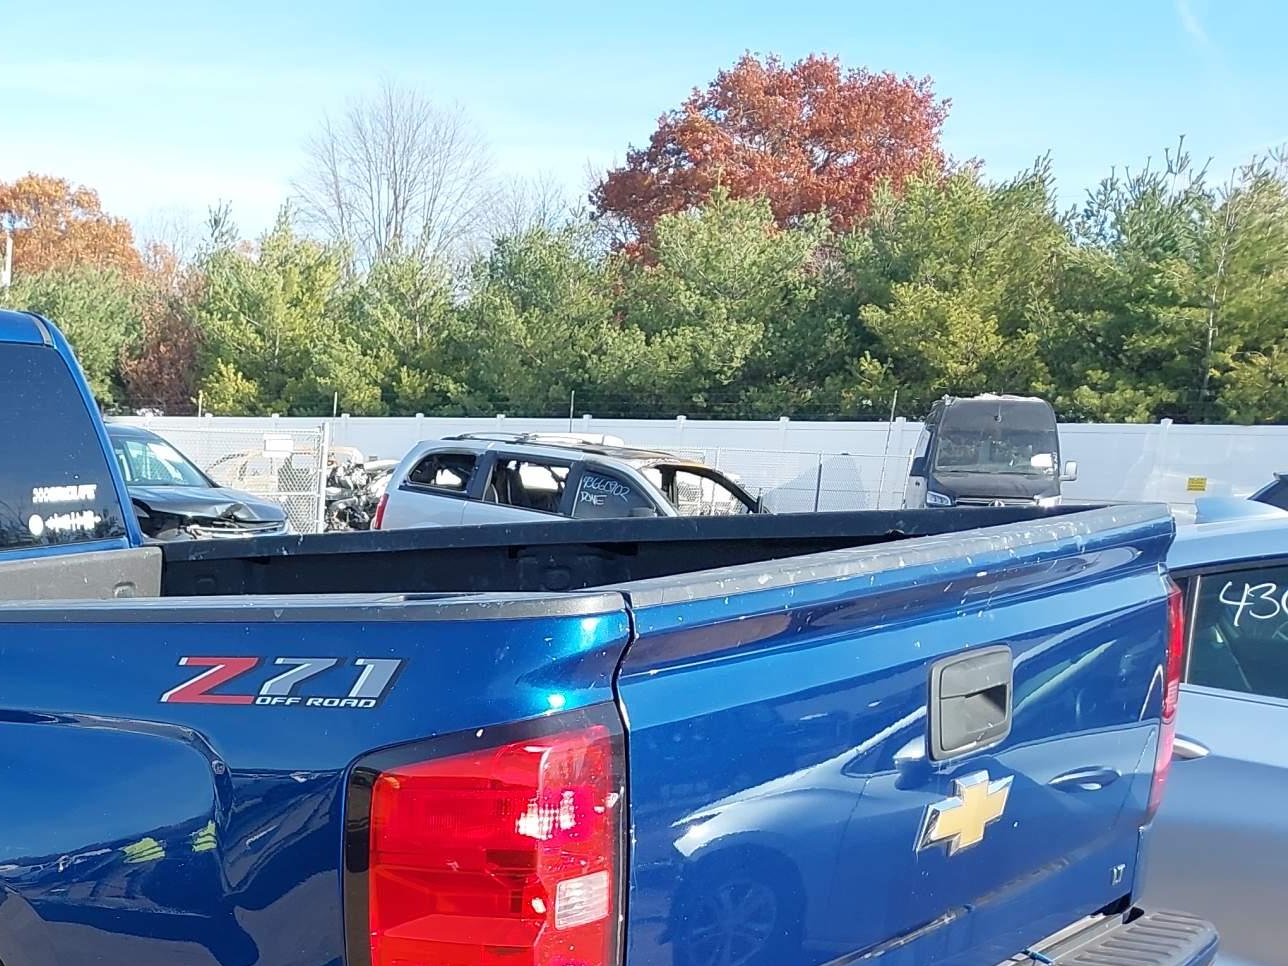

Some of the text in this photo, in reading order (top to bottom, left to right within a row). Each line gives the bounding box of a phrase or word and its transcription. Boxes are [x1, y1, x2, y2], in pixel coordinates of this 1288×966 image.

[580, 490, 607, 506] DONE
[160, 656, 402, 705] Z71
[255, 696, 377, 708] OFF ROAD
